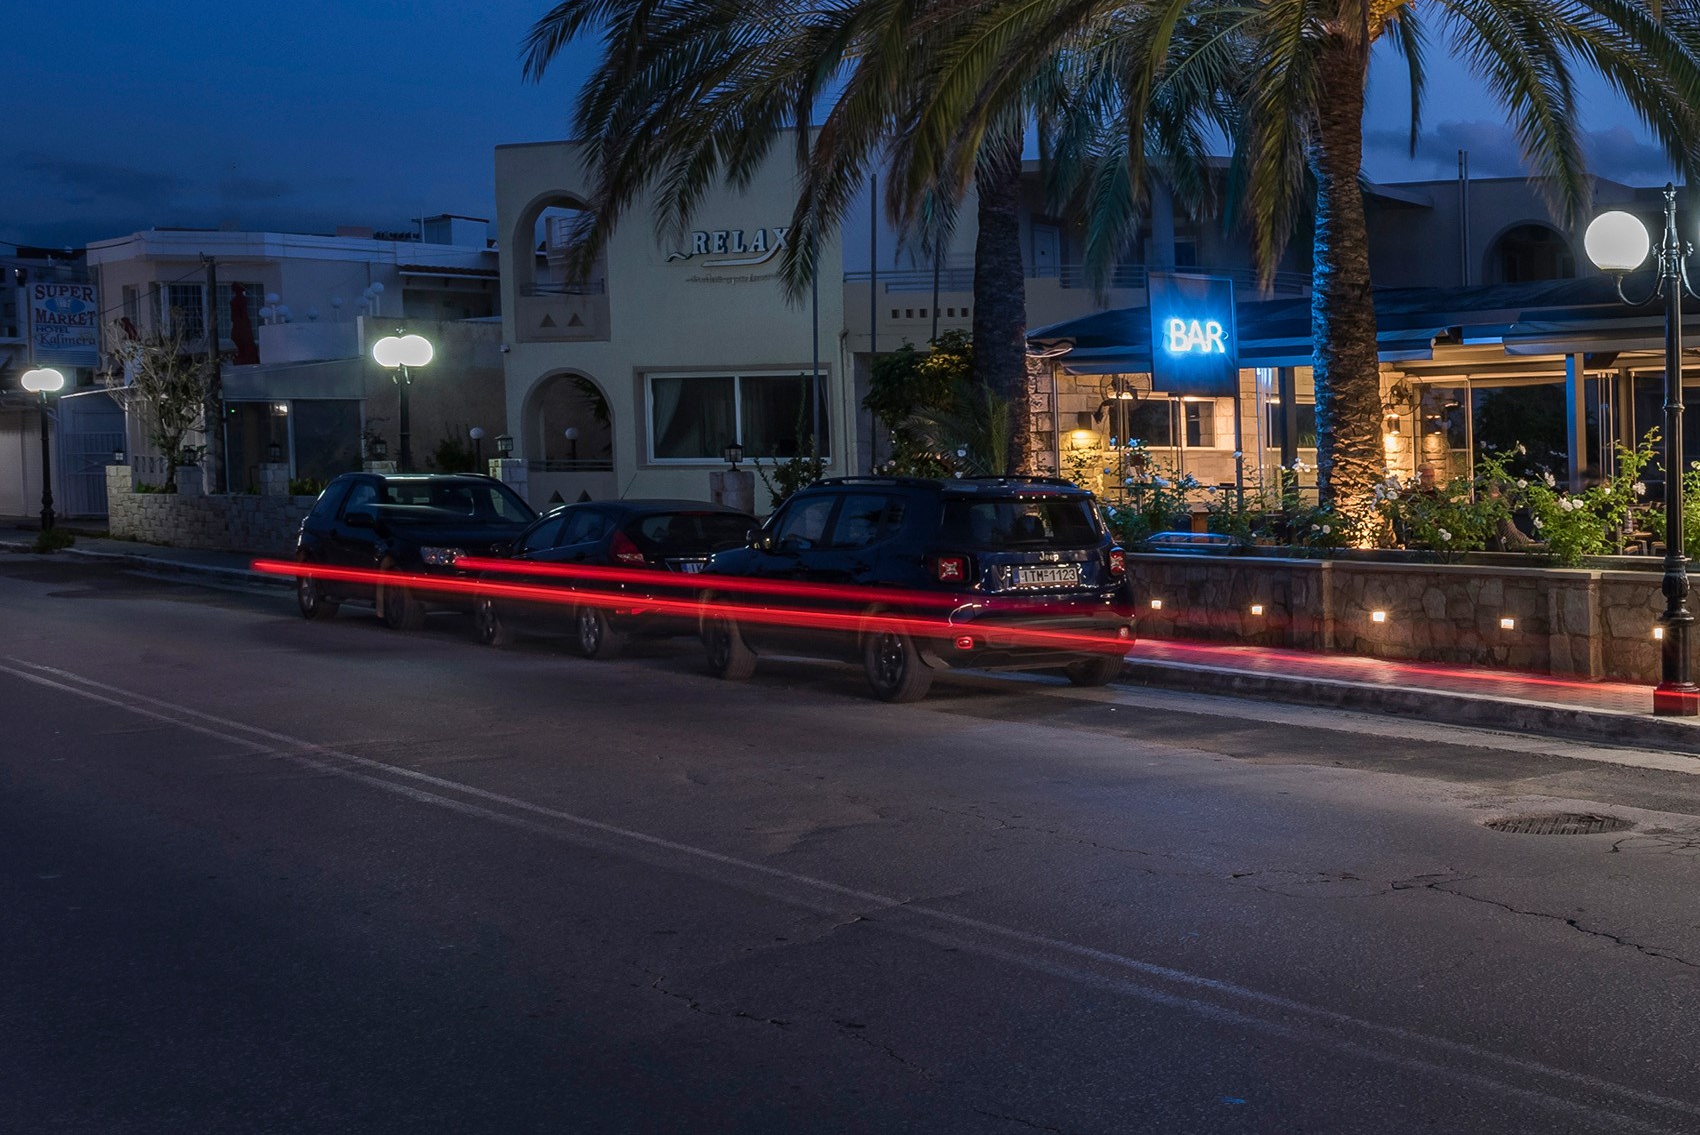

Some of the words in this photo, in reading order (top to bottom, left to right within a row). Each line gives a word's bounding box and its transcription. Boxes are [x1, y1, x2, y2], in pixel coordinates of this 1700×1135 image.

[691, 228, 790, 254] RELAX
[35, 284, 95, 303] SUPER
[35, 307, 96, 325] MARKET
[35, 326, 70, 334] HOTEL
[1169, 318, 1225, 354] BAR
[1040, 551, 1059, 562] Jeep
